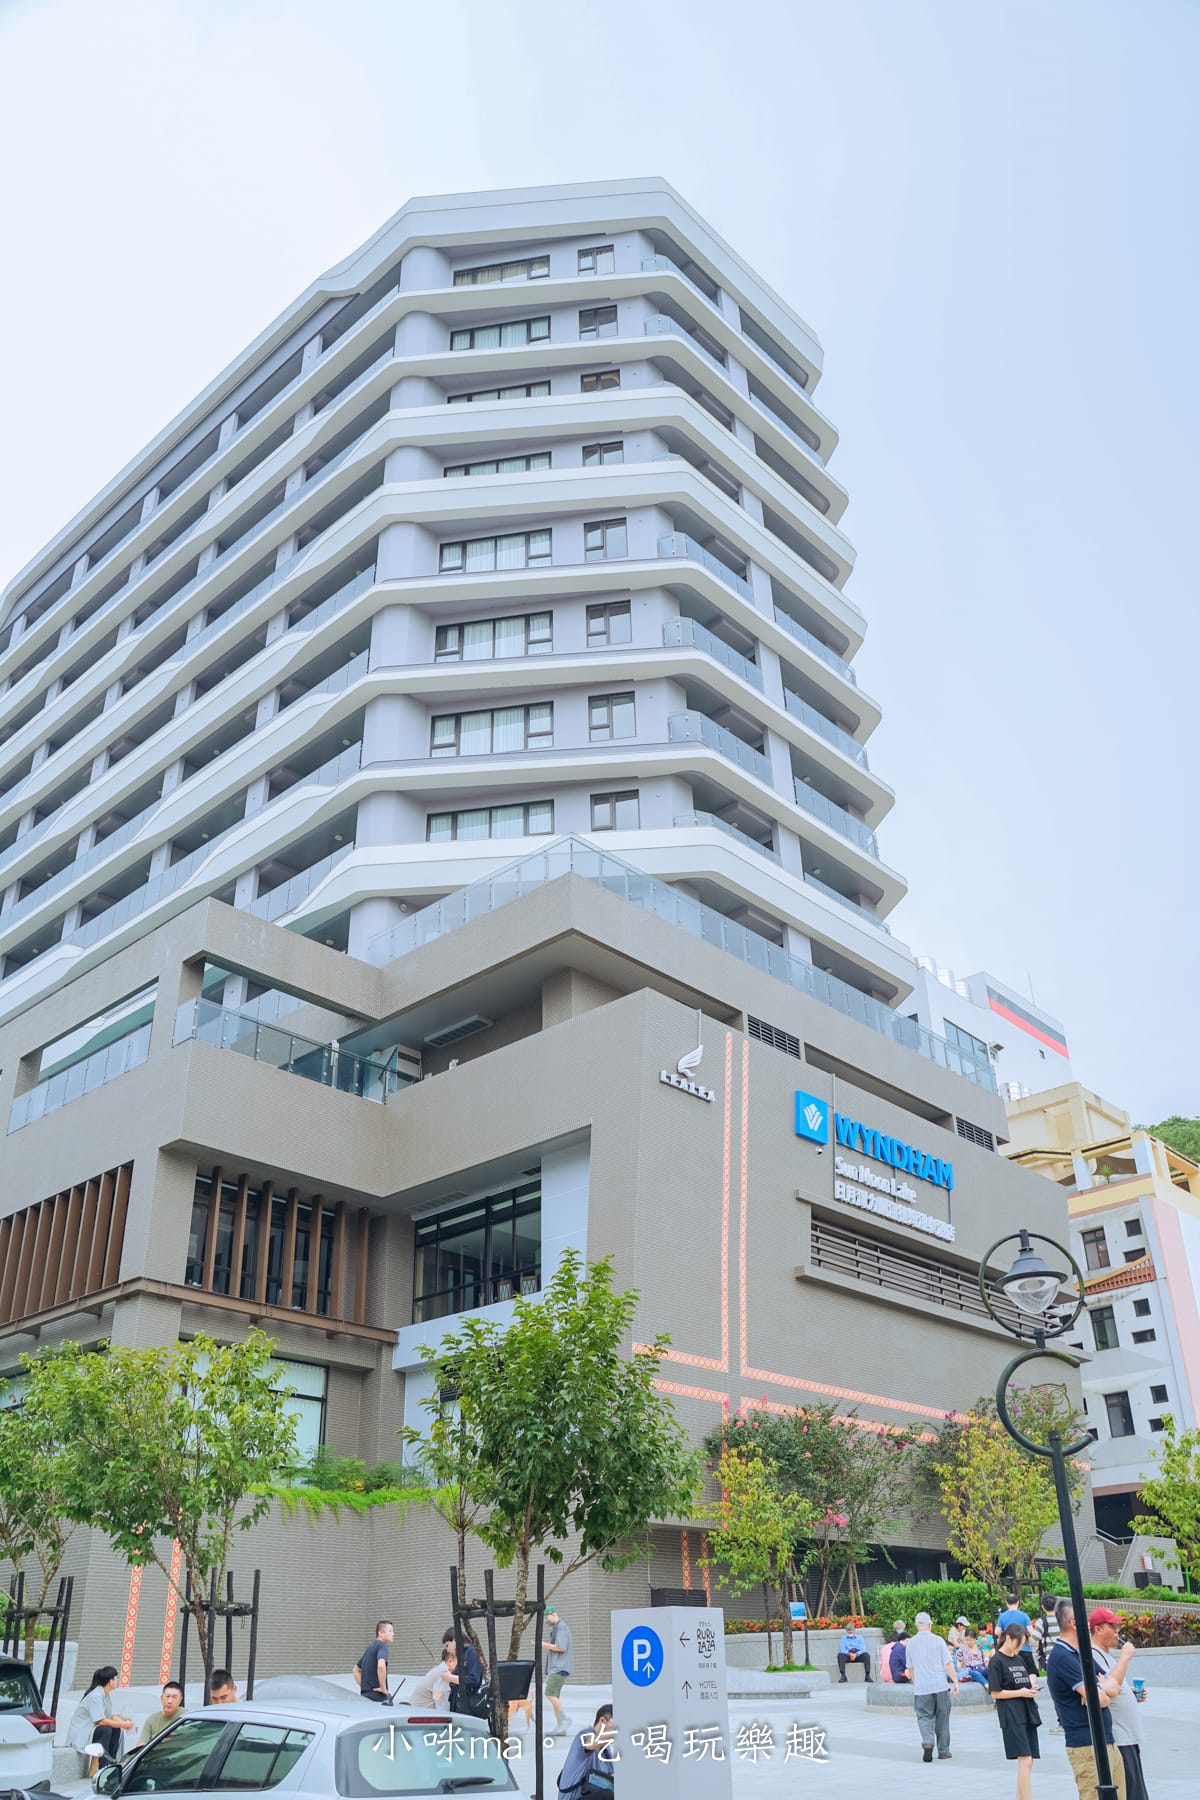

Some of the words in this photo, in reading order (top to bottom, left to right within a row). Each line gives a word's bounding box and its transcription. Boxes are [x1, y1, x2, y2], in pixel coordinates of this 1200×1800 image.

[660, 1070, 716, 1102] LEALEA
[834, 1112, 954, 1191] WYNDHAM
[835, 1156, 859, 1180] Sun
[859, 1164, 891, 1195] Moon
[891, 1177, 917, 1203] Lake
[633, 1638, 652, 1672] P
[698, 1640, 716, 1654] ZAZA
[699, 1680, 718, 1689] HOTEL
